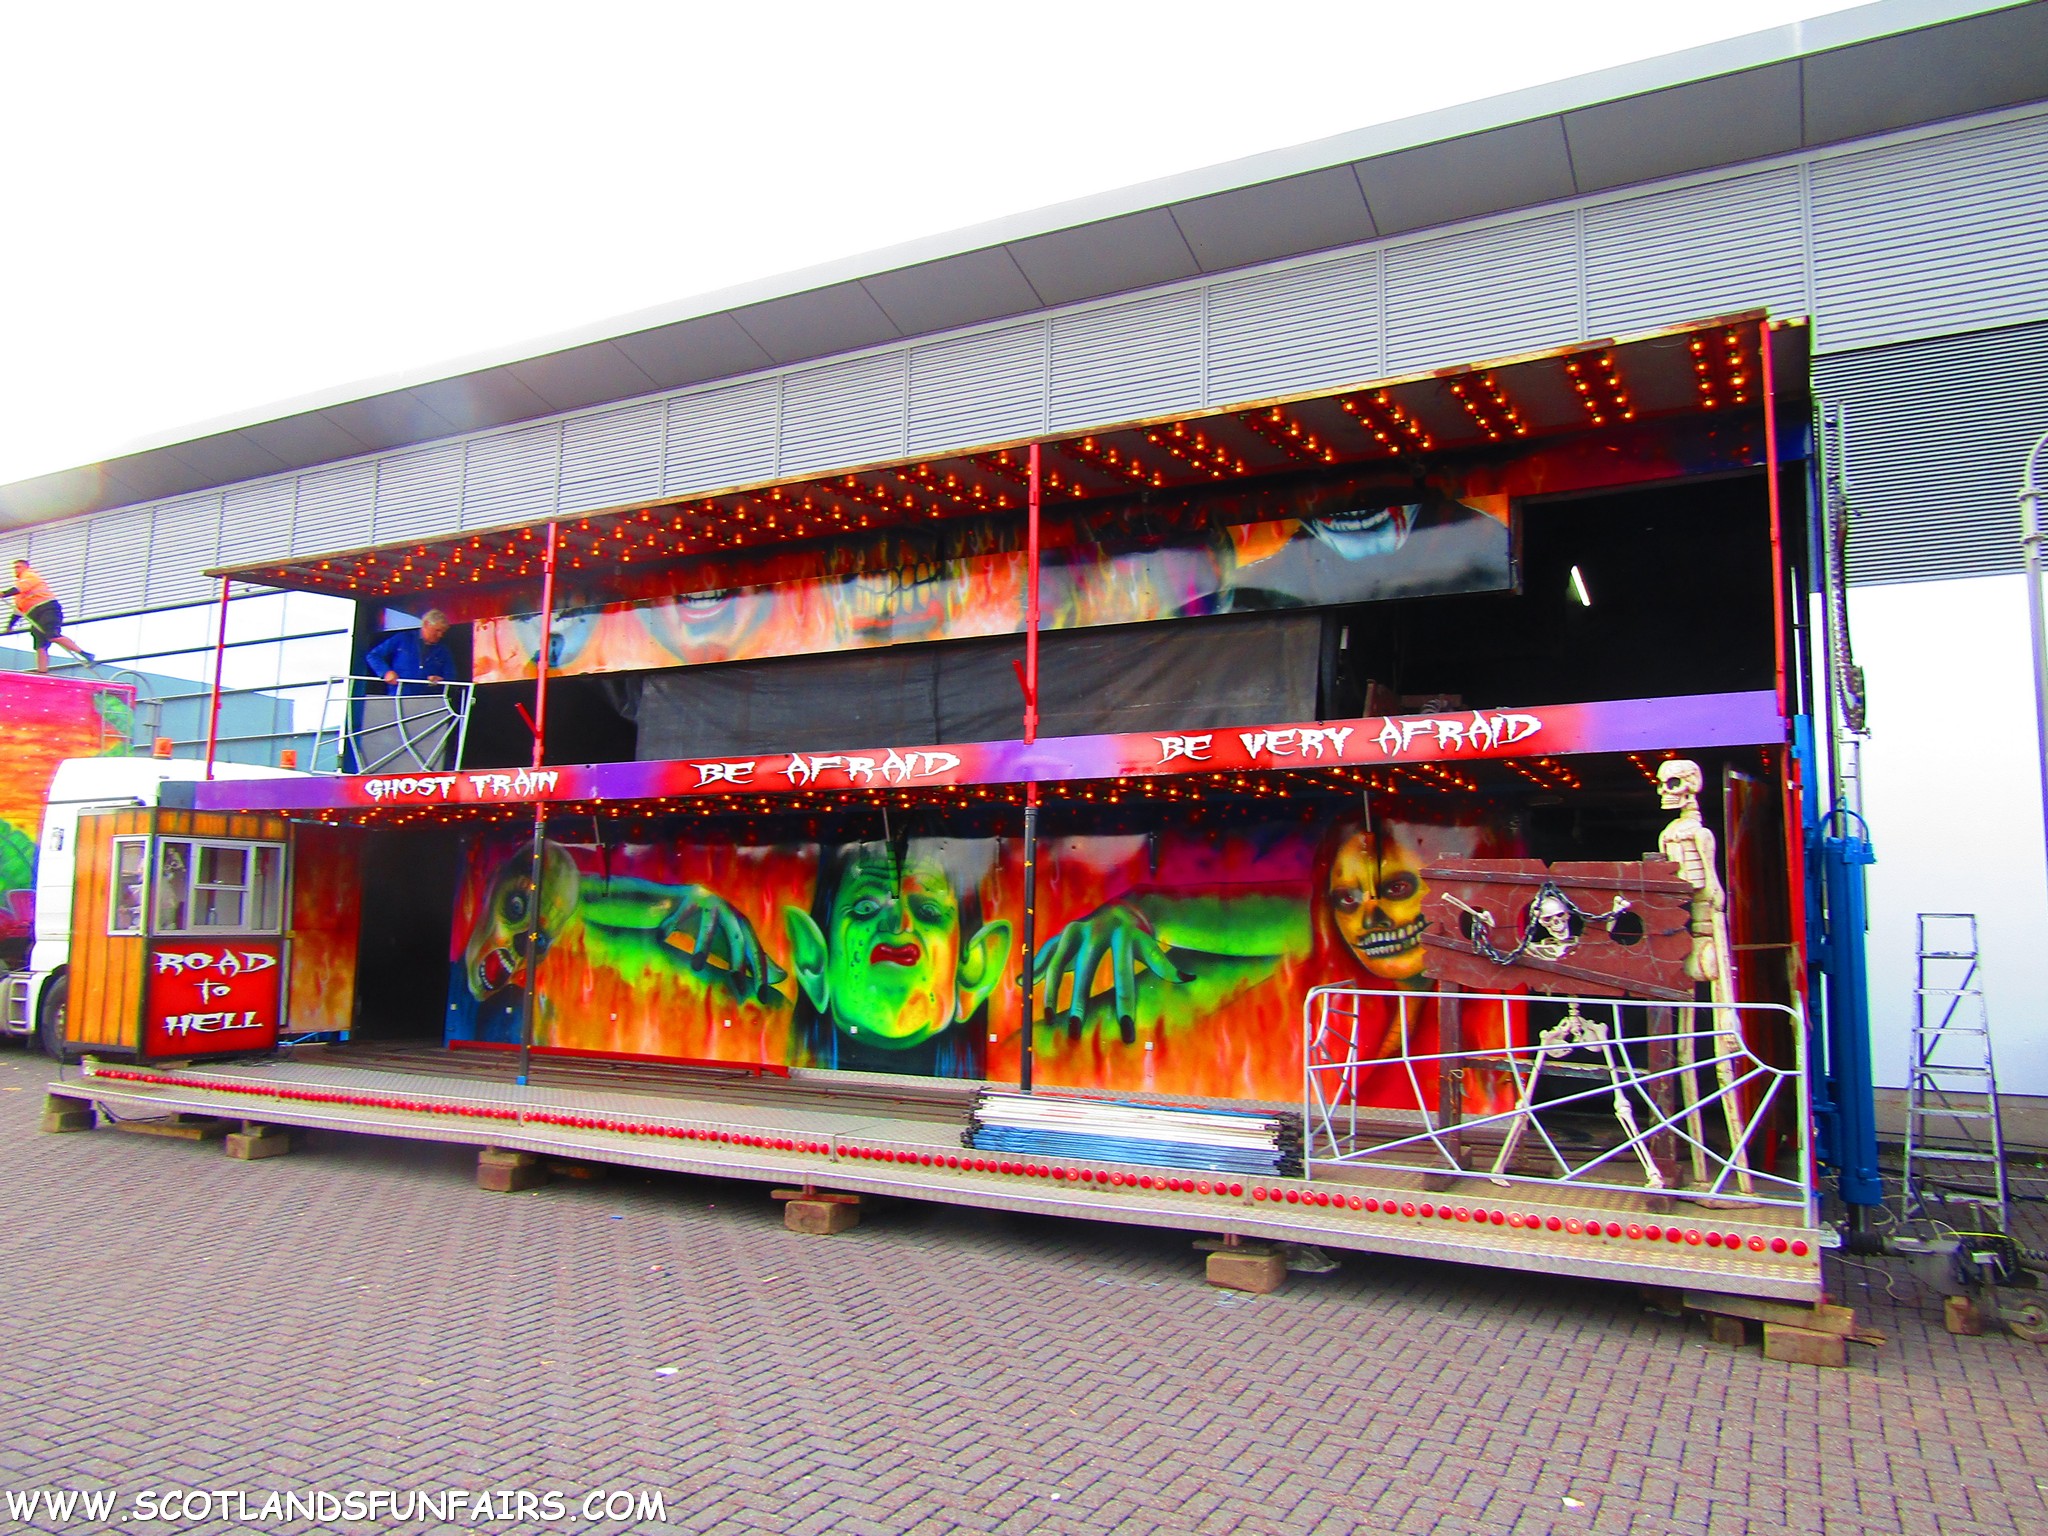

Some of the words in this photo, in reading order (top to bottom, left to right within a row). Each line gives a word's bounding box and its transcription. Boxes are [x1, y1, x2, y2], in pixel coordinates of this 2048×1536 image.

[1152, 733, 1213, 765] BE
[1239, 727, 1355, 760] VERY
[1370, 710, 1543, 757] AFRAID
[364, 774, 457, 802] GHOST
[468, 768, 559, 797] TRAIN
[692, 761, 756, 788] BE
[779, 748, 961, 788] AFRAID
[152, 948, 277, 978] ROAD
[162, 1011, 263, 1037] HELL
